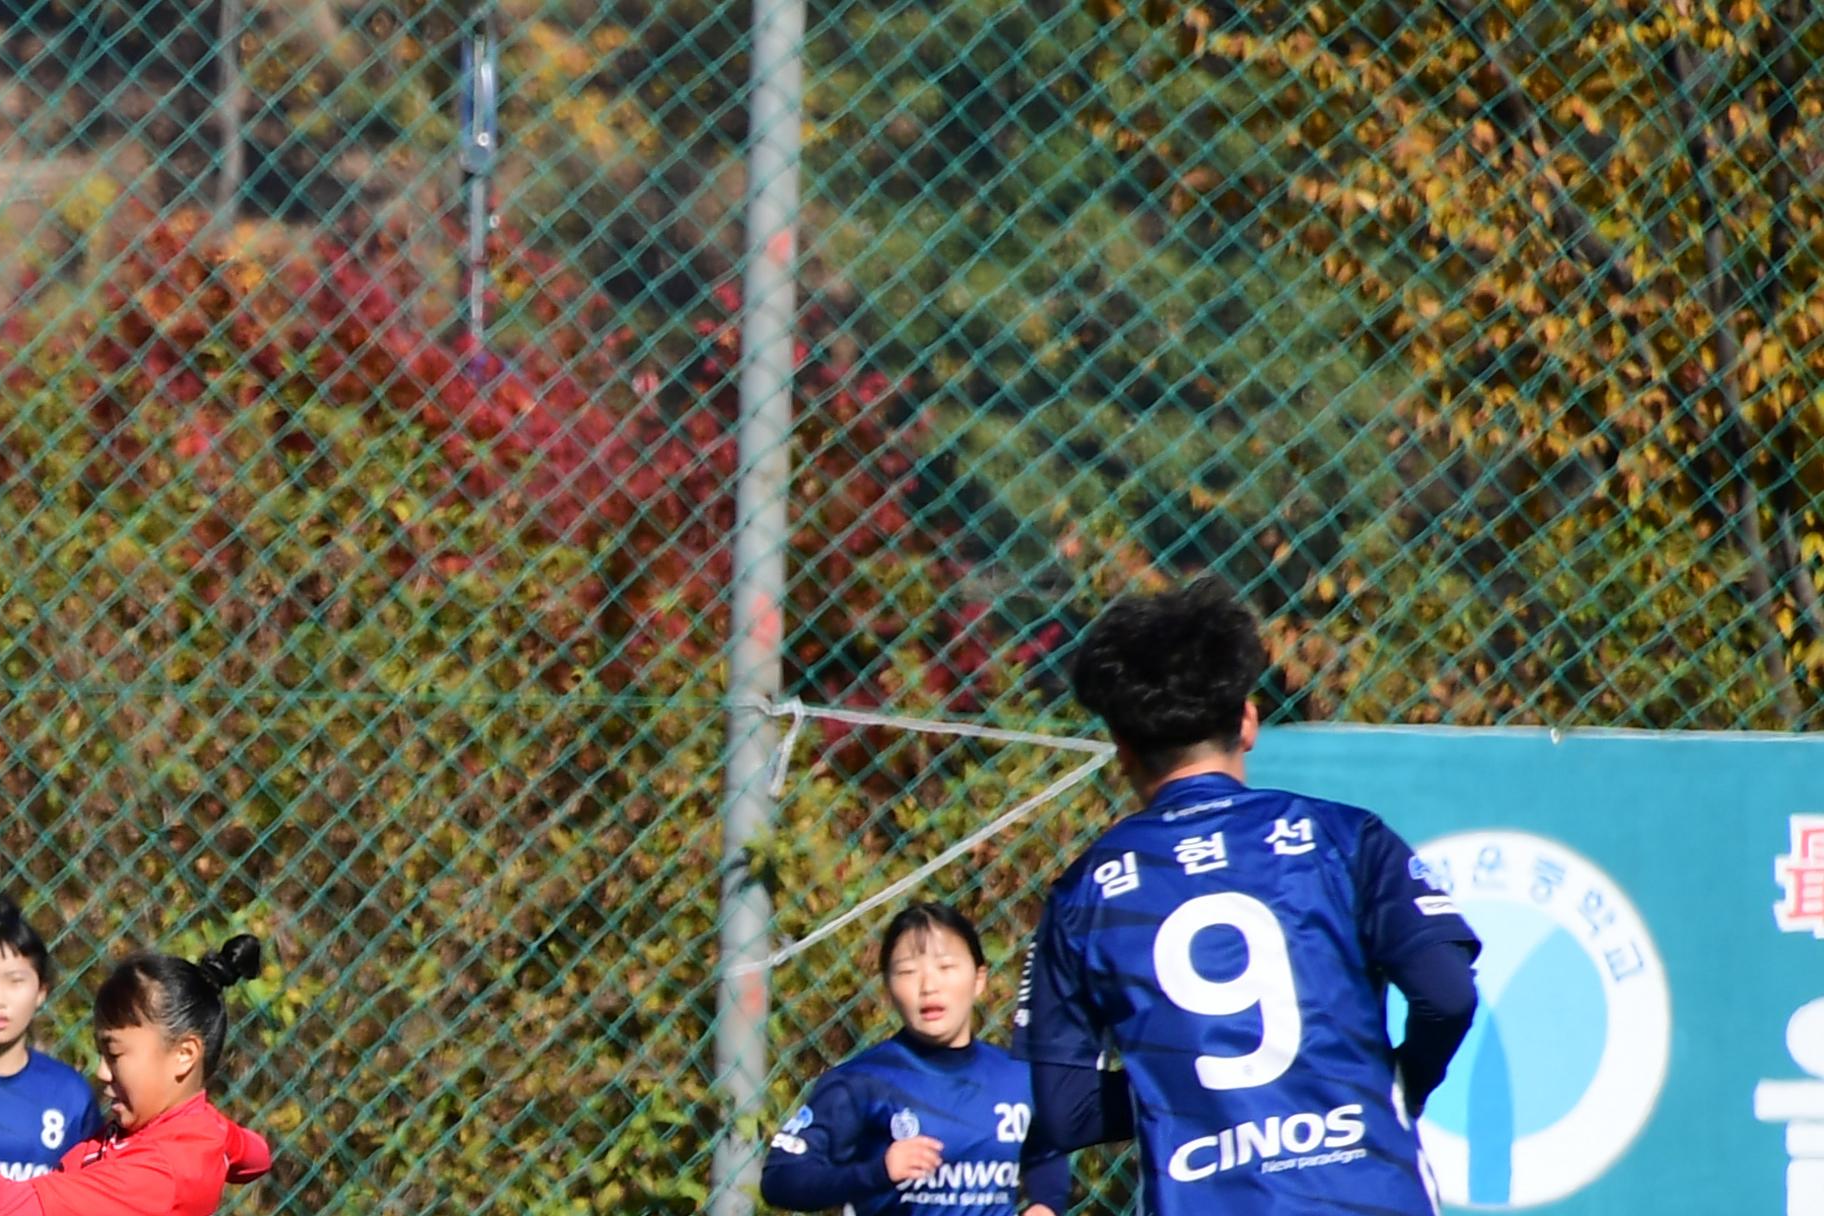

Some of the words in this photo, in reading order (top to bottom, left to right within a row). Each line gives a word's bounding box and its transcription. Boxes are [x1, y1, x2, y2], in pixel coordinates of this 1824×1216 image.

[1153, 891, 1303, 1091] 9
[40, 1109, 65, 1149] 8
[994, 1102, 1032, 1143] 20
[1168, 1104, 1365, 1182] CINOS
